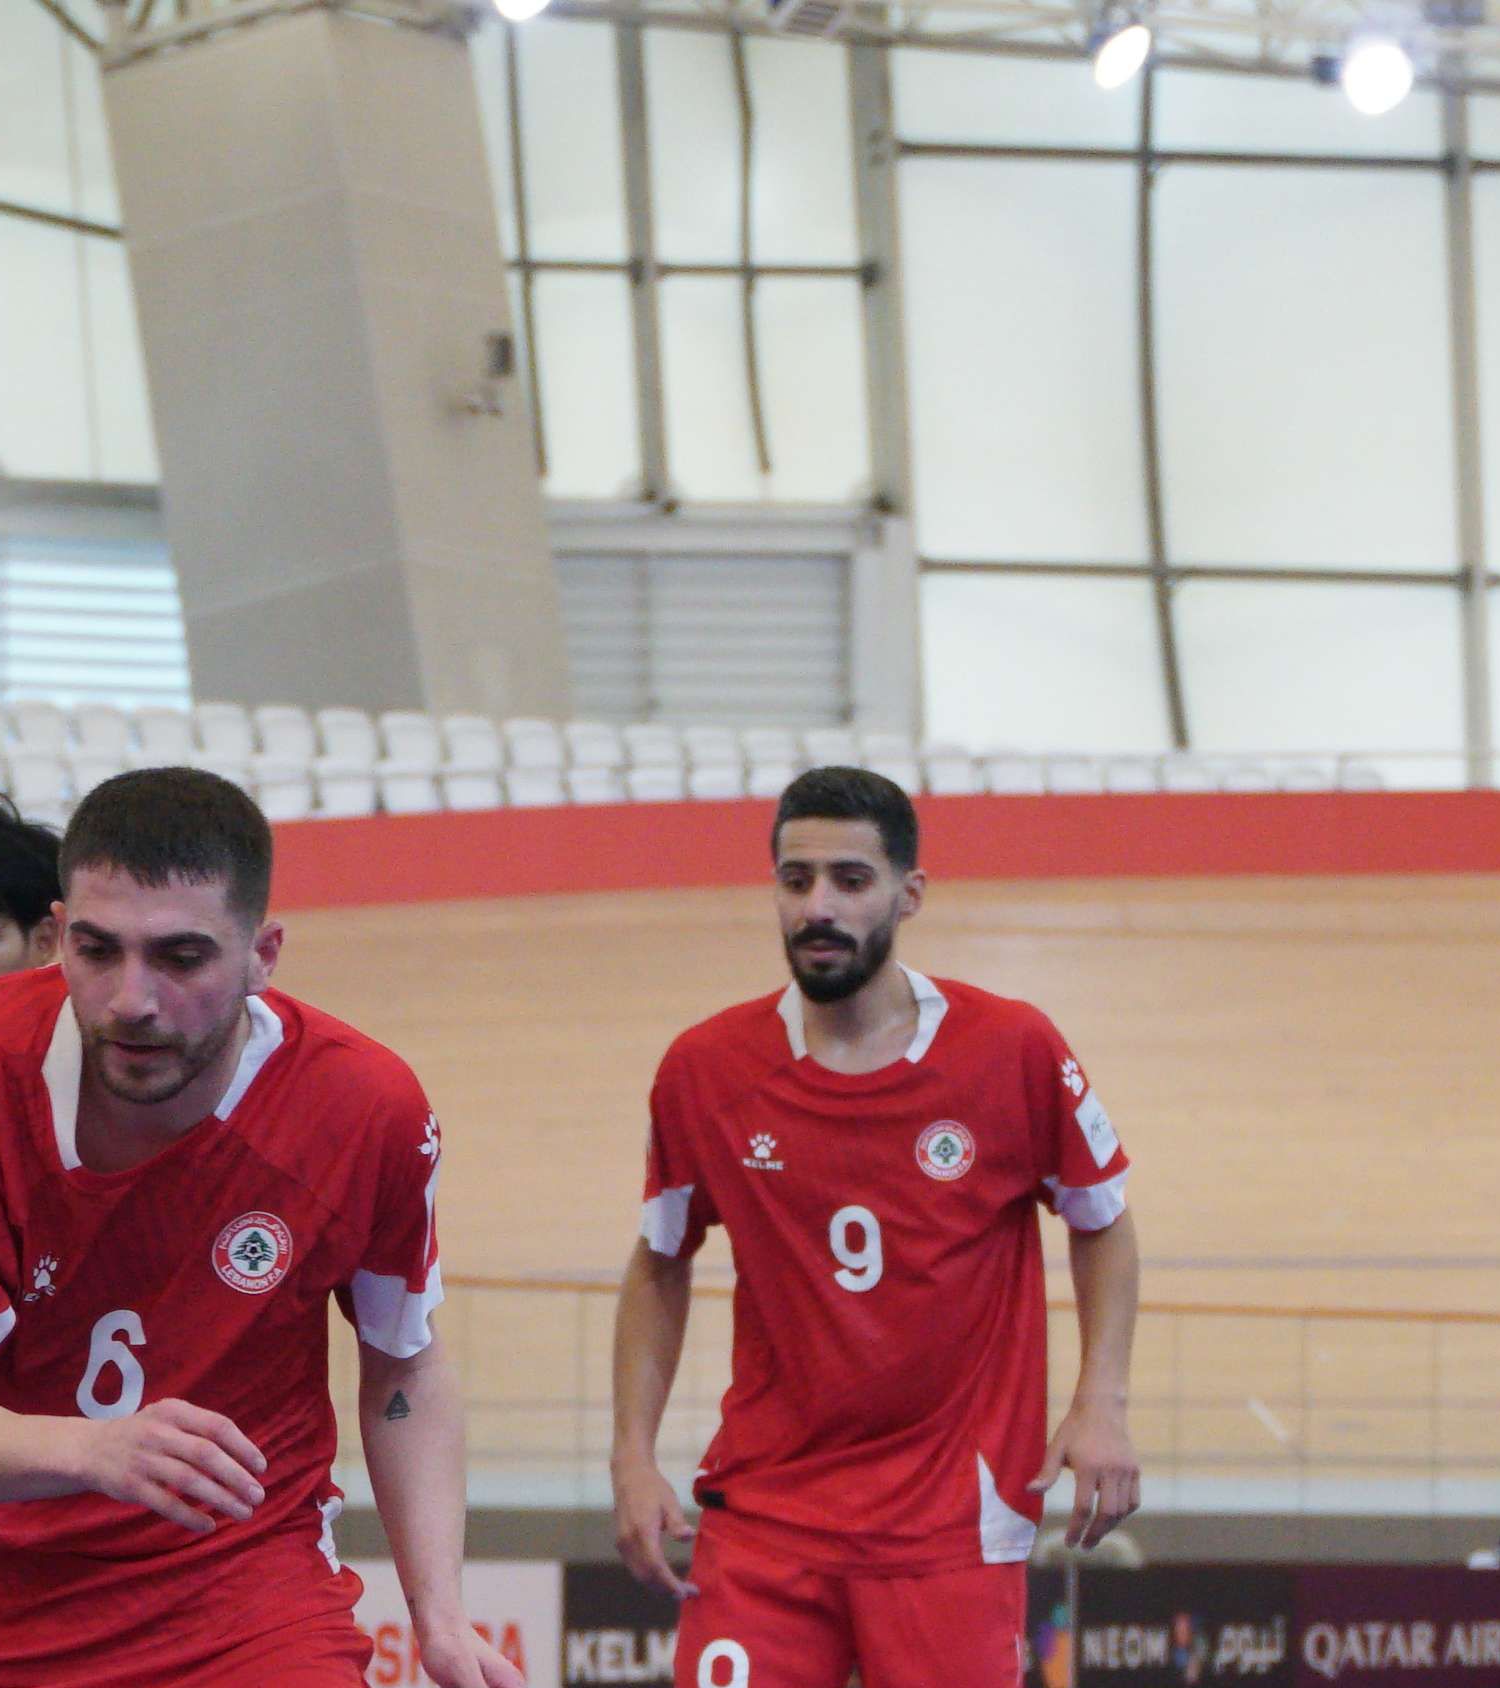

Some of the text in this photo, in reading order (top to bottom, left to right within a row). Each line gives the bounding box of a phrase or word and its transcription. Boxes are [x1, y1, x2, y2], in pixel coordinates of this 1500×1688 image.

[829, 1205, 883, 1293] 9
[76, 1309, 146, 1421] 6
[1081, 1626, 1168, 1668] NEOM
[1303, 1622, 1435, 1678] QATAR
